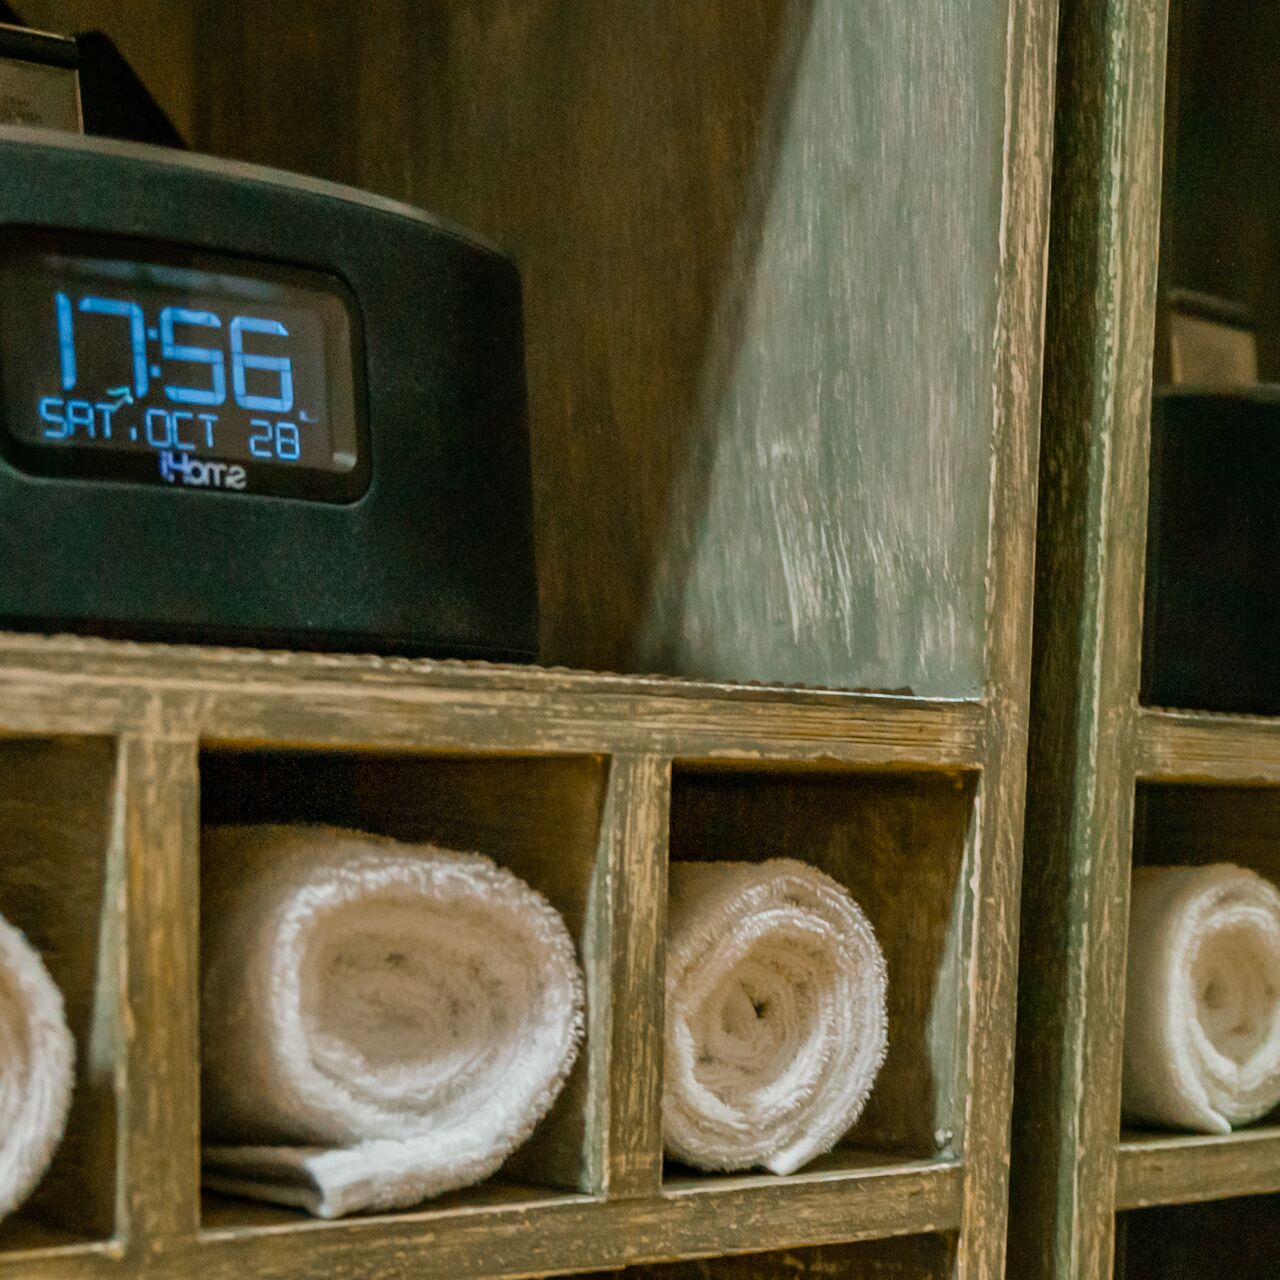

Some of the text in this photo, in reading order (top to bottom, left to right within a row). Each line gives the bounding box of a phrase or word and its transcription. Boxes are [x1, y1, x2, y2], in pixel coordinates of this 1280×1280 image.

[54, 292, 294, 413] 17:56
[145, 408, 218, 451] OCT
[248, 418, 301, 461] 28
